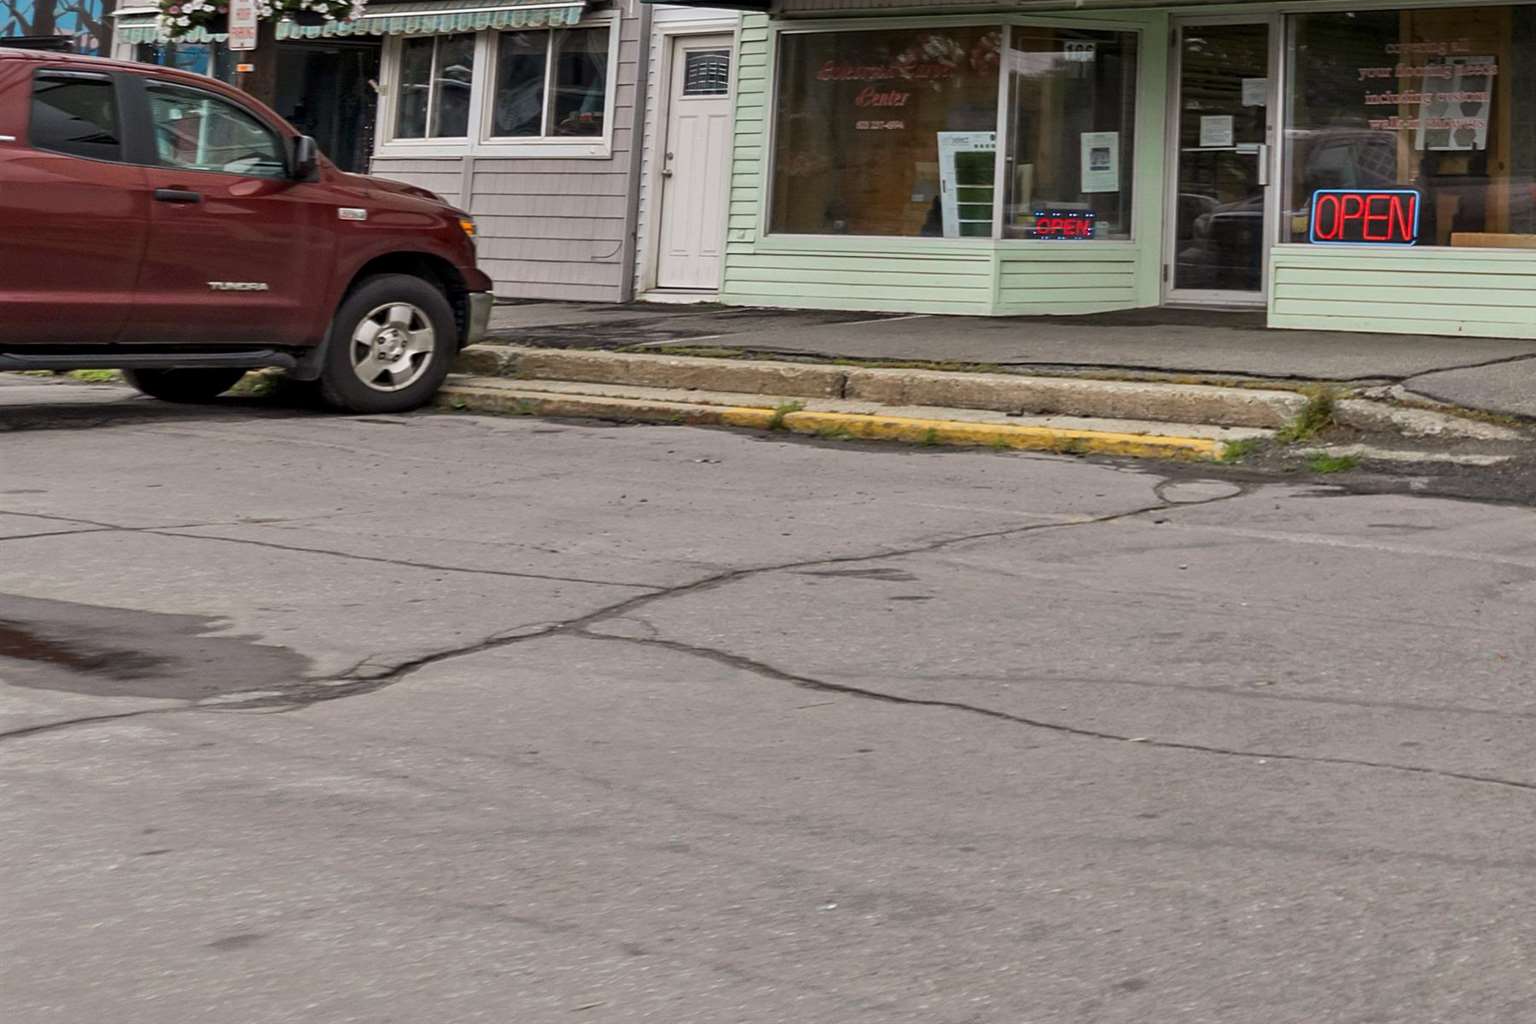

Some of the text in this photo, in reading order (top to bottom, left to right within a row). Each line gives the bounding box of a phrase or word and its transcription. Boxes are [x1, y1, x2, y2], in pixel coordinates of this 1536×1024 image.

[1358, 67, 1393, 81] your
[855, 87, 911, 107] Center
[1364, 89, 1433, 107] including
[1034, 218, 1090, 234] OPEN
[1314, 194, 1416, 241] OPEN
[207, 281, 269, 291] TUNDRA
